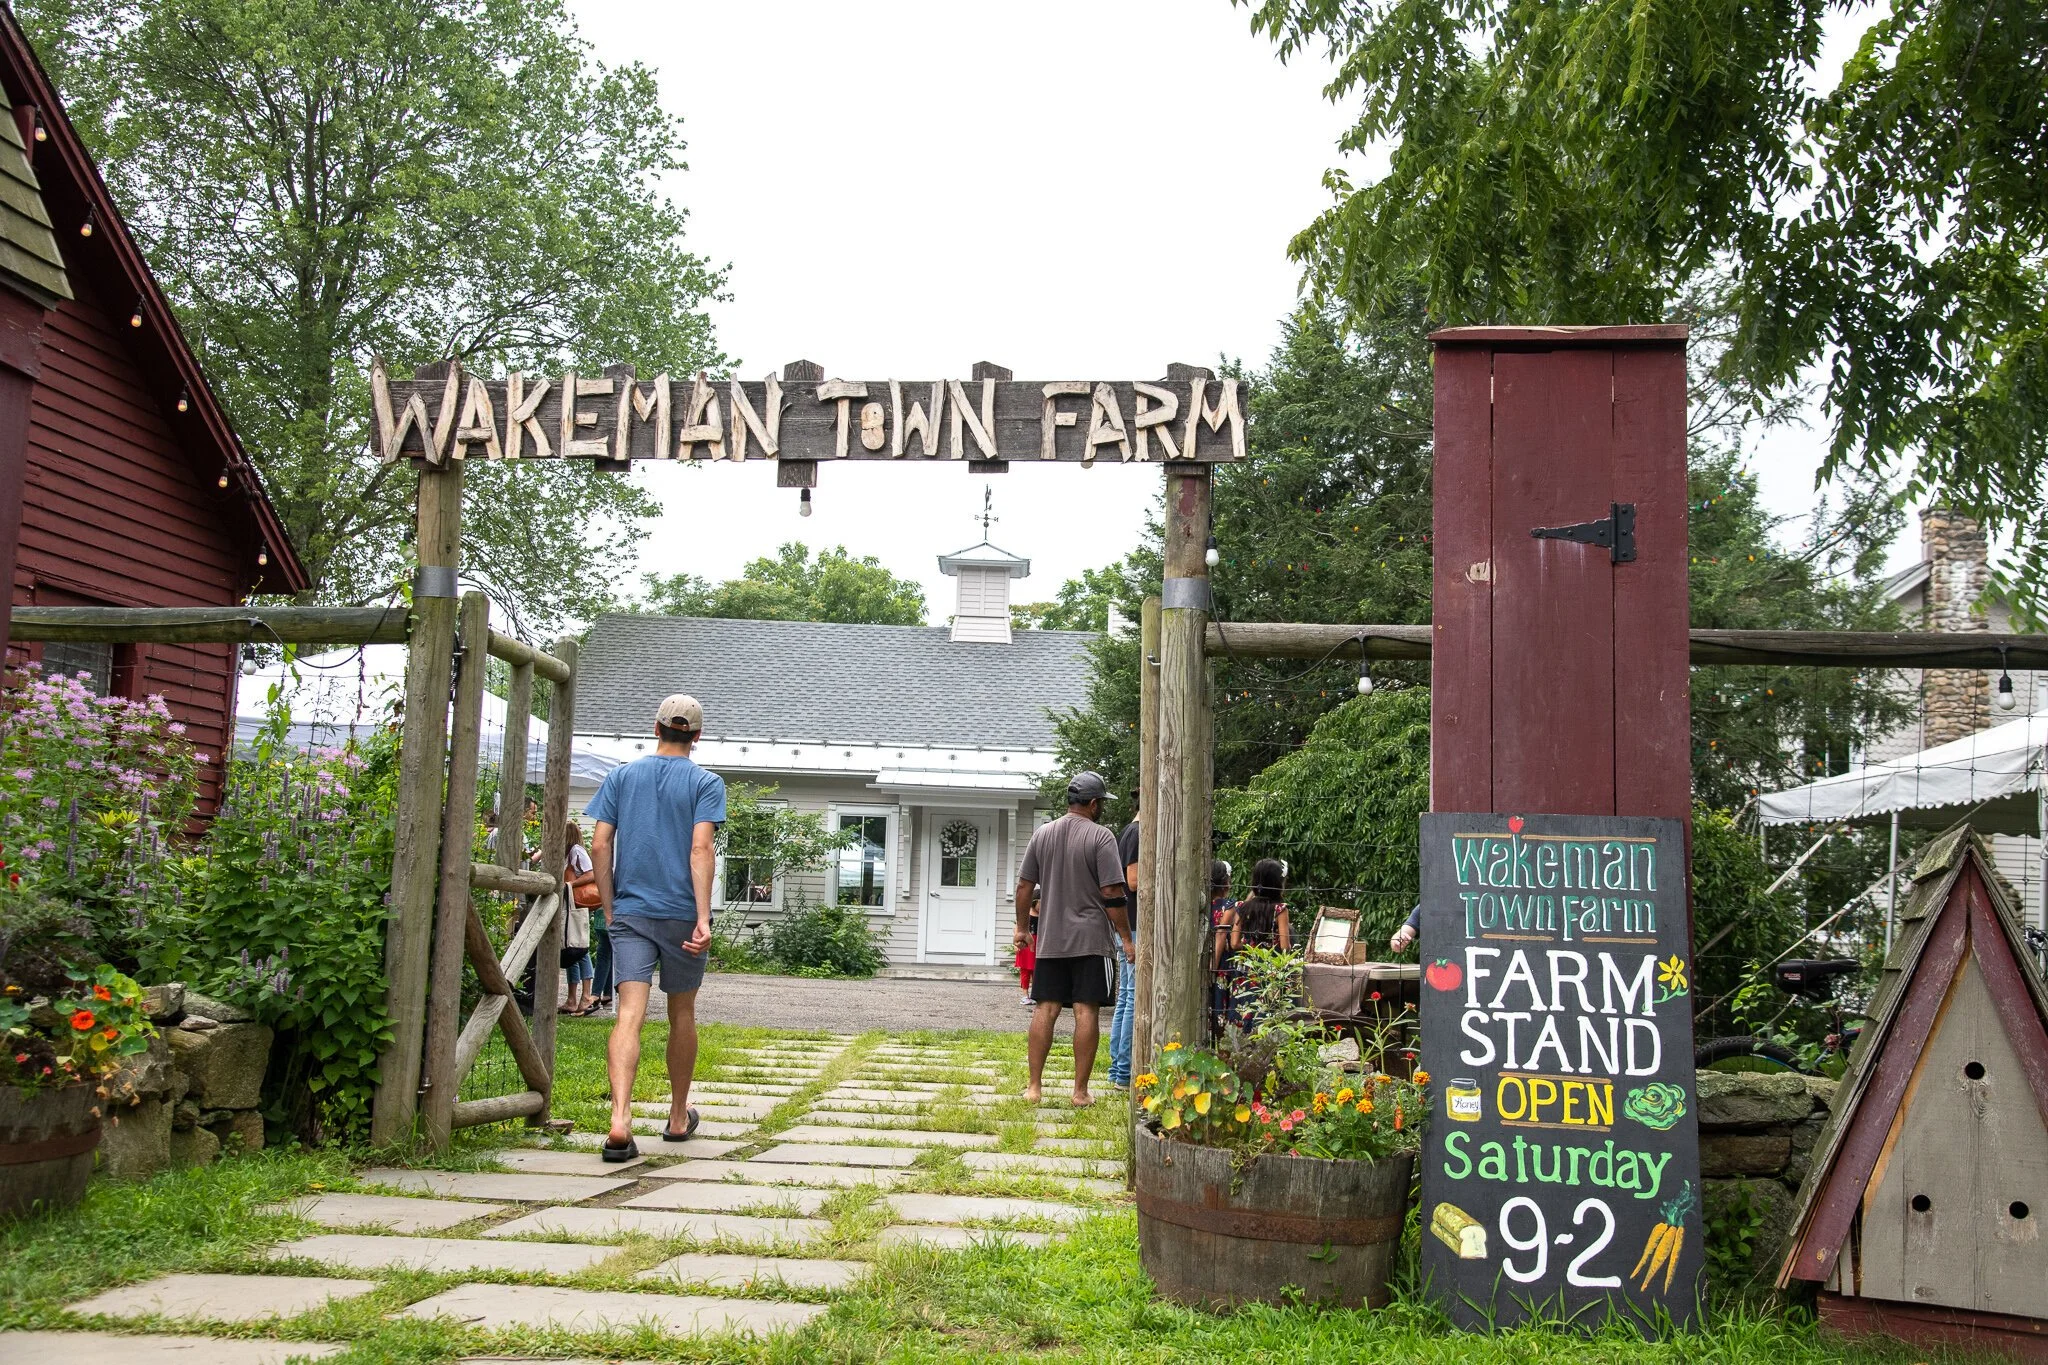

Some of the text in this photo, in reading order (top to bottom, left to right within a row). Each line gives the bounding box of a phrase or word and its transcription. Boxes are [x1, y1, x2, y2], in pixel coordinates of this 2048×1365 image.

[371, 353, 1246, 466] WAKEMAN TOWN FARM
[1562, 894, 1657, 941] Farm
[1464, 946, 1657, 1016] FARM
[1460, 1009, 1661, 1076] STAND
[1454, 1097, 1479, 1111] Honey
[1497, 1077, 1614, 1126] OPEN
[1444, 1130, 1672, 1199] Saturday
[1499, 1196, 1622, 1288] 9-2
